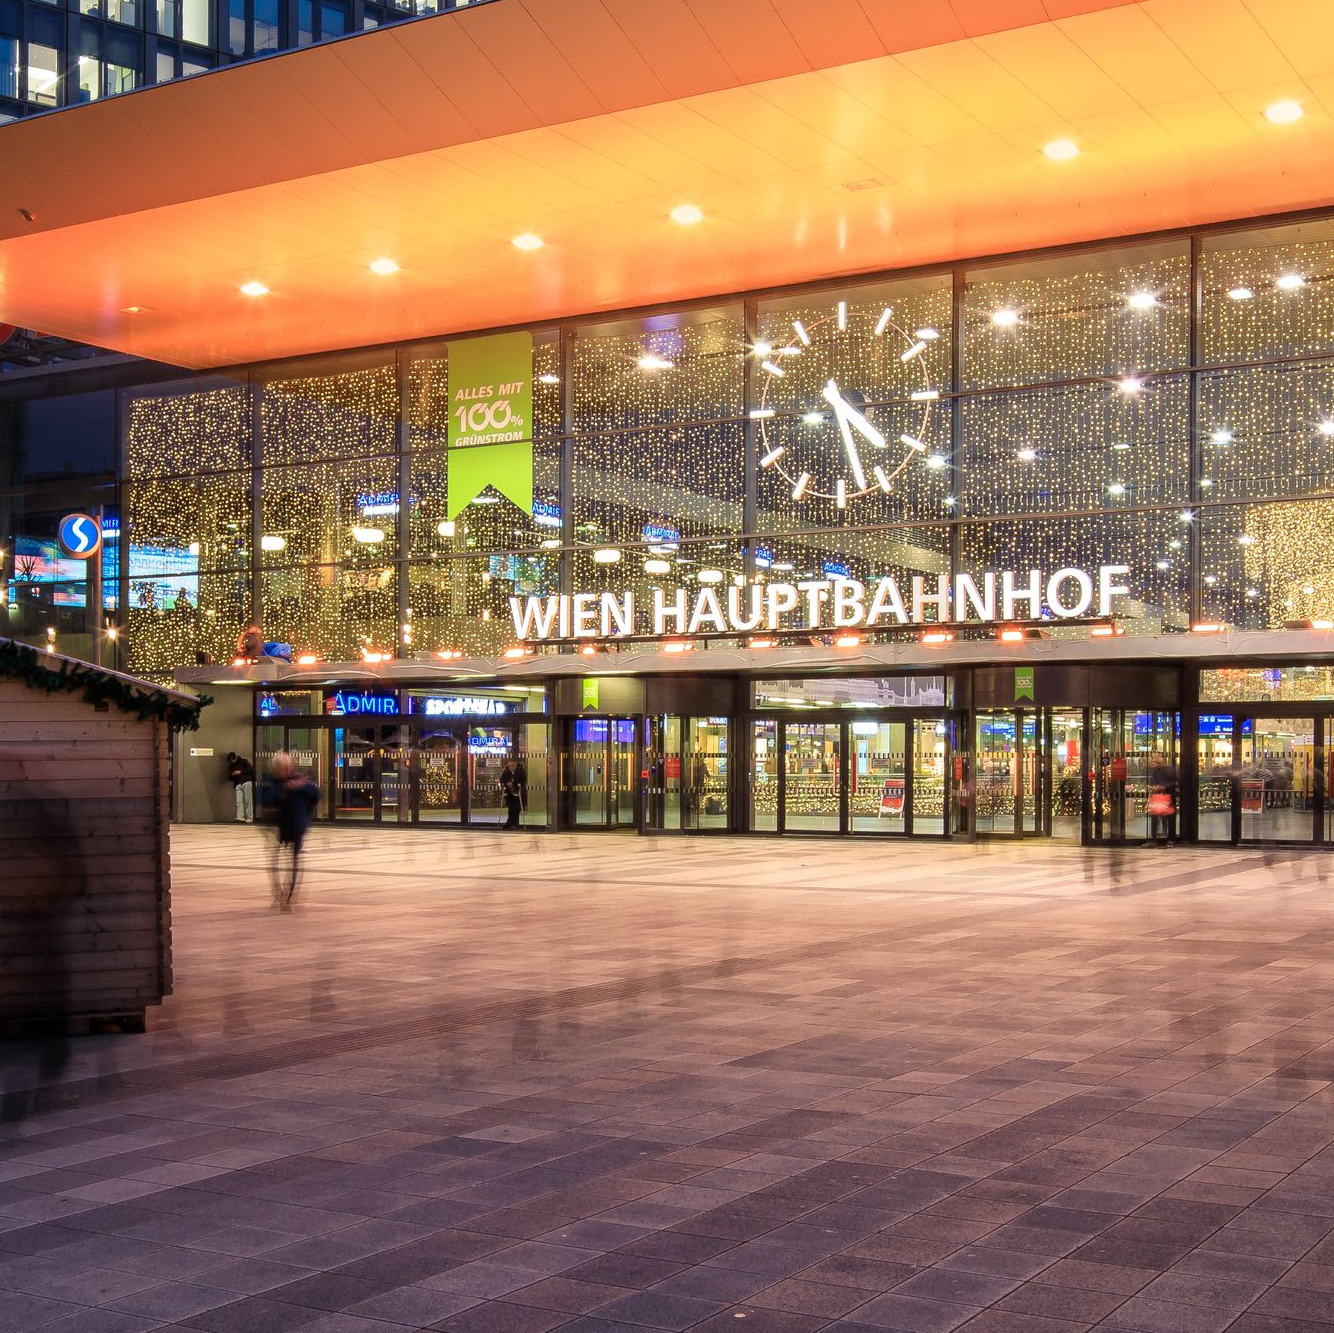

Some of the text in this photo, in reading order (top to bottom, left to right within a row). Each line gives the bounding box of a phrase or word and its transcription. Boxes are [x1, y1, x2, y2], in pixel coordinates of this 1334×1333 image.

[455, 381, 524, 401] ALLES MIT
[454, 400, 524, 433] 100%
[455, 430, 524, 447] GRÜNSTROM
[509, 565, 1132, 640] WIEN HAUPTBAHNHOF
